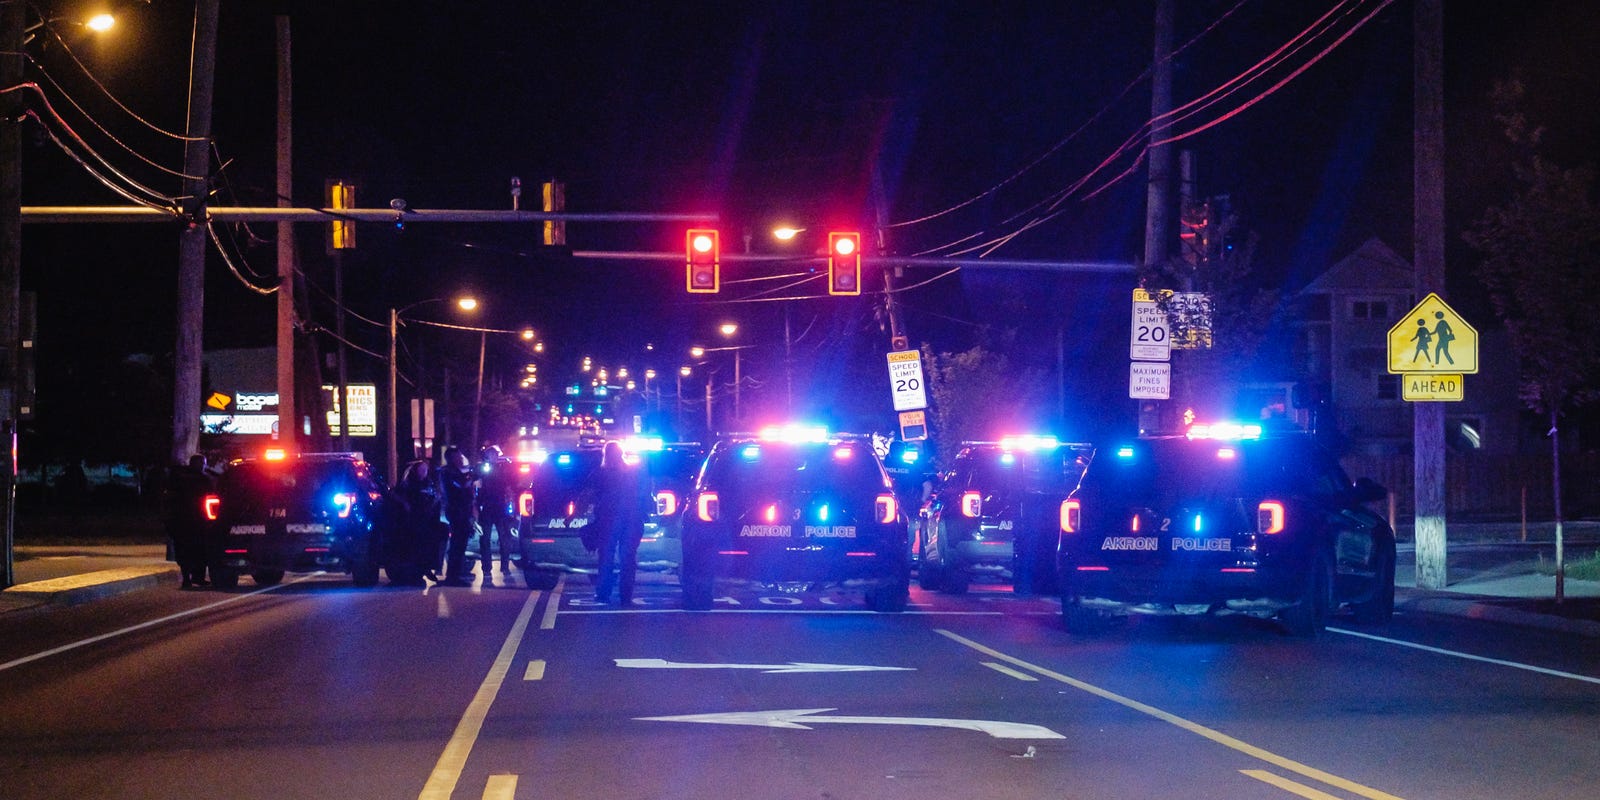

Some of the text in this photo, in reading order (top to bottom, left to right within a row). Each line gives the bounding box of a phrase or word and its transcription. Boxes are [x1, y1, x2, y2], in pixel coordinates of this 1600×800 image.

[1139, 316, 1164, 324] LIMIT
[1137, 325, 1166, 342] 20
[889, 353, 918, 361] SCHOOL
[892, 362, 918, 371] SPEED
[895, 370, 916, 378] LIMIT
[1139, 376, 1161, 384] FINES
[896, 378, 919, 392] 20
[1133, 385, 1166, 394] IMPOSED
[1411, 380, 1456, 393] AHEAD
[793, 508, 802, 520] 3
[230, 523, 325, 535] AKRON POLICE
[1160, 518, 1171, 532] 2
[740, 525, 857, 538] AKRON POLICE
[1101, 536, 1232, 552] AKRON POLICE
